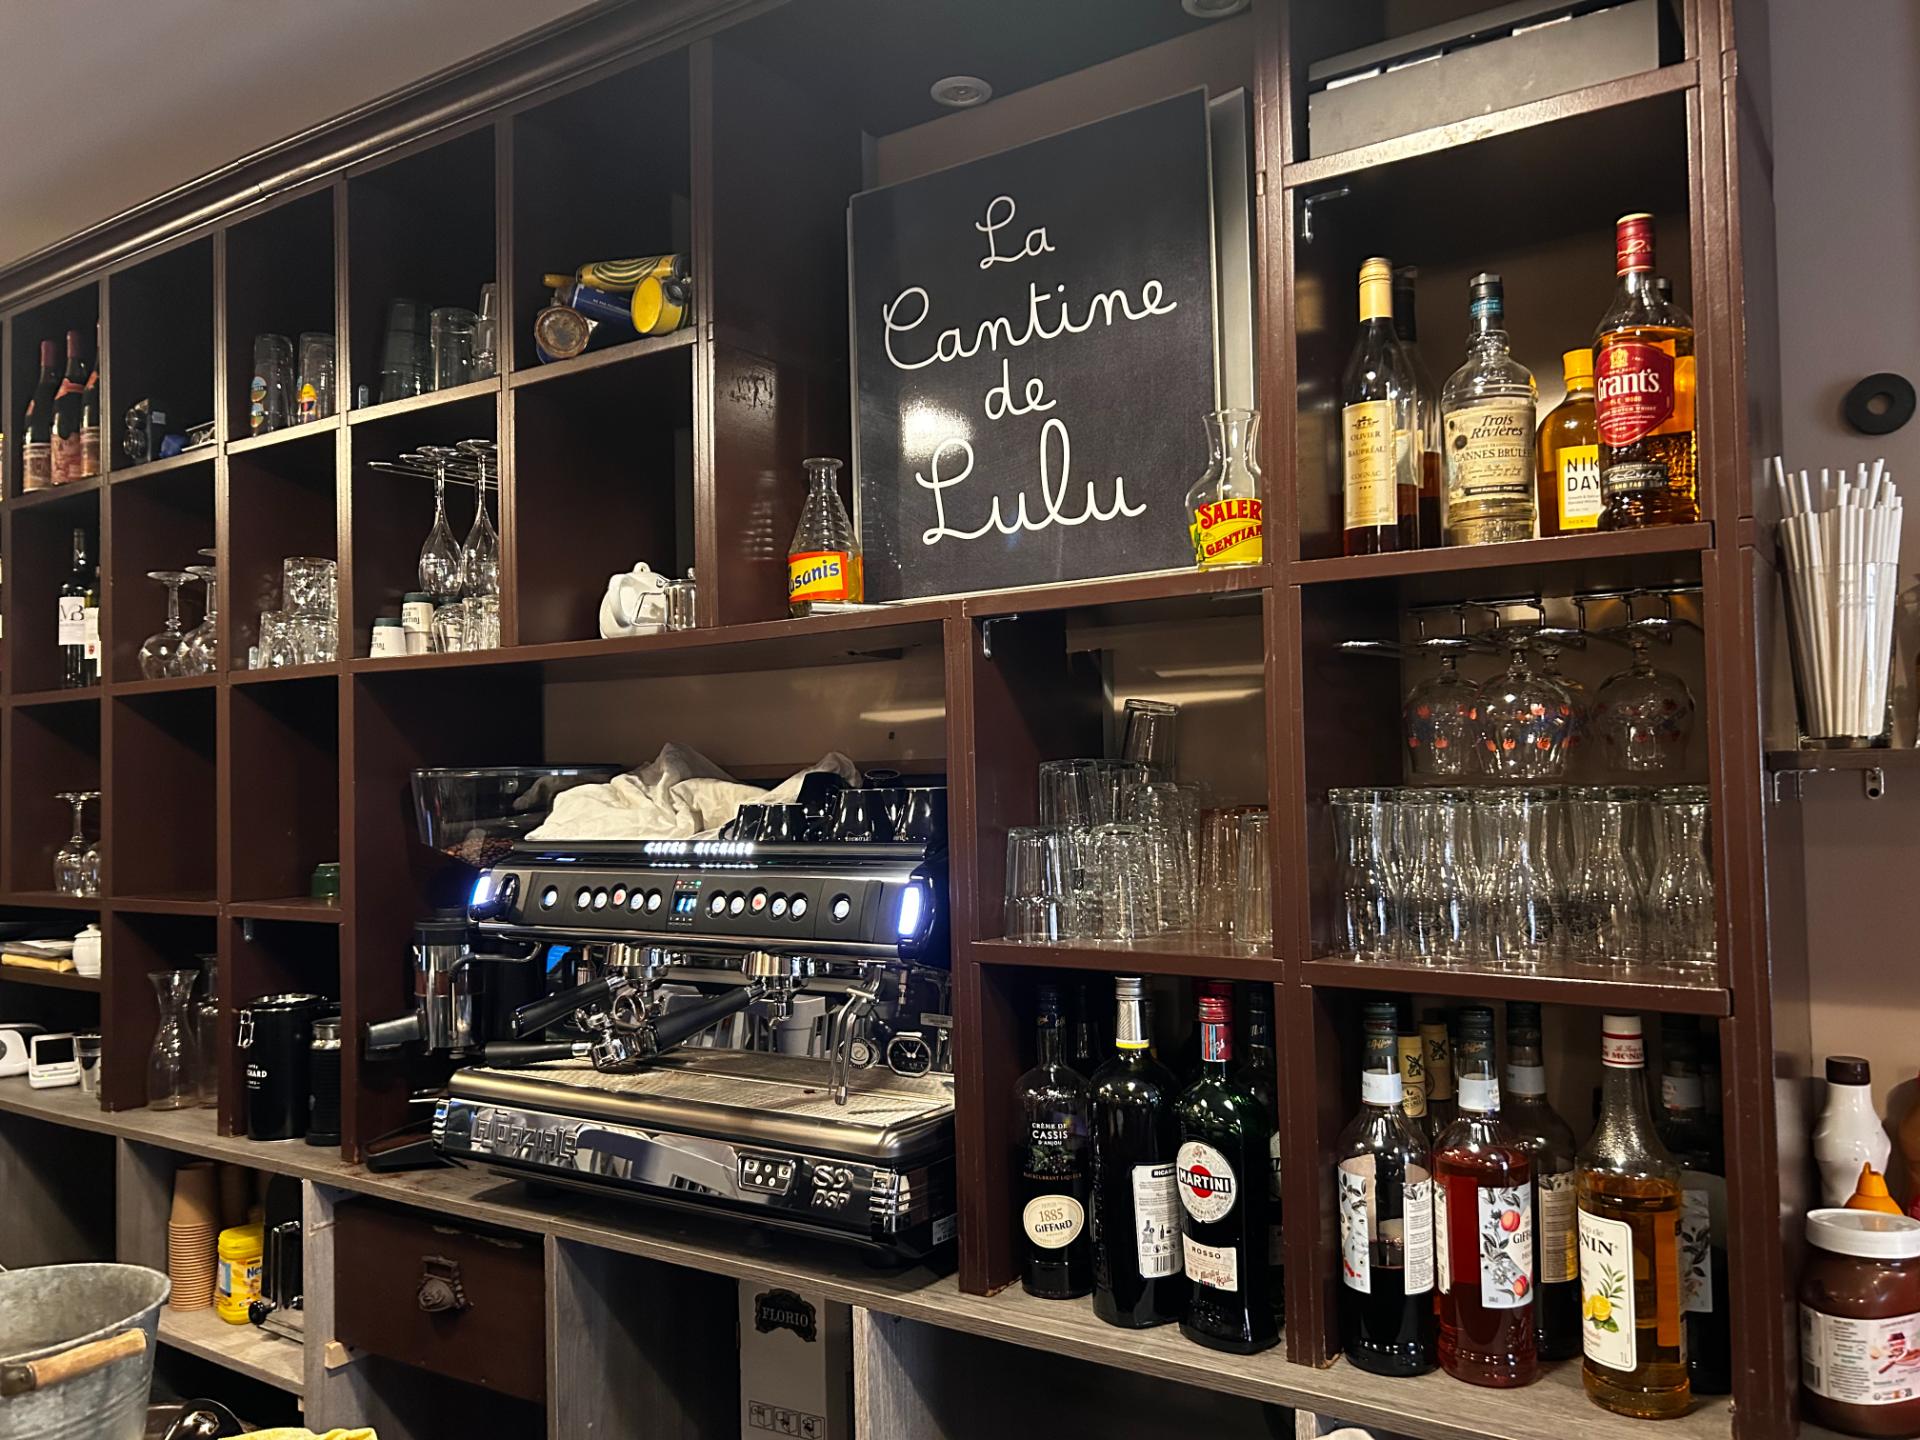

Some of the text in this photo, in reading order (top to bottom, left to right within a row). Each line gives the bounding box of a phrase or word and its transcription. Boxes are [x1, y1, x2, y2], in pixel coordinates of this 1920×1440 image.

[975, 195, 1055, 269] La
[883, 279, 1178, 370] Cantine
[984, 358, 1057, 420] de
[1482, 414, 1514, 427] Trois
[916, 418, 1147, 546] Lulu
[1199, 499, 1263, 530] SALER
[1031, 1130, 1068, 1140] CASSIS
[1179, 1170, 1230, 1193] MARTINI
[1034, 1219, 1073, 1233] GIFFARD
[1039, 1207, 1064, 1223] 1885
[1191, 1246, 1221, 1260] ROSSO
[762, 1306, 809, 1328] FLORIO
